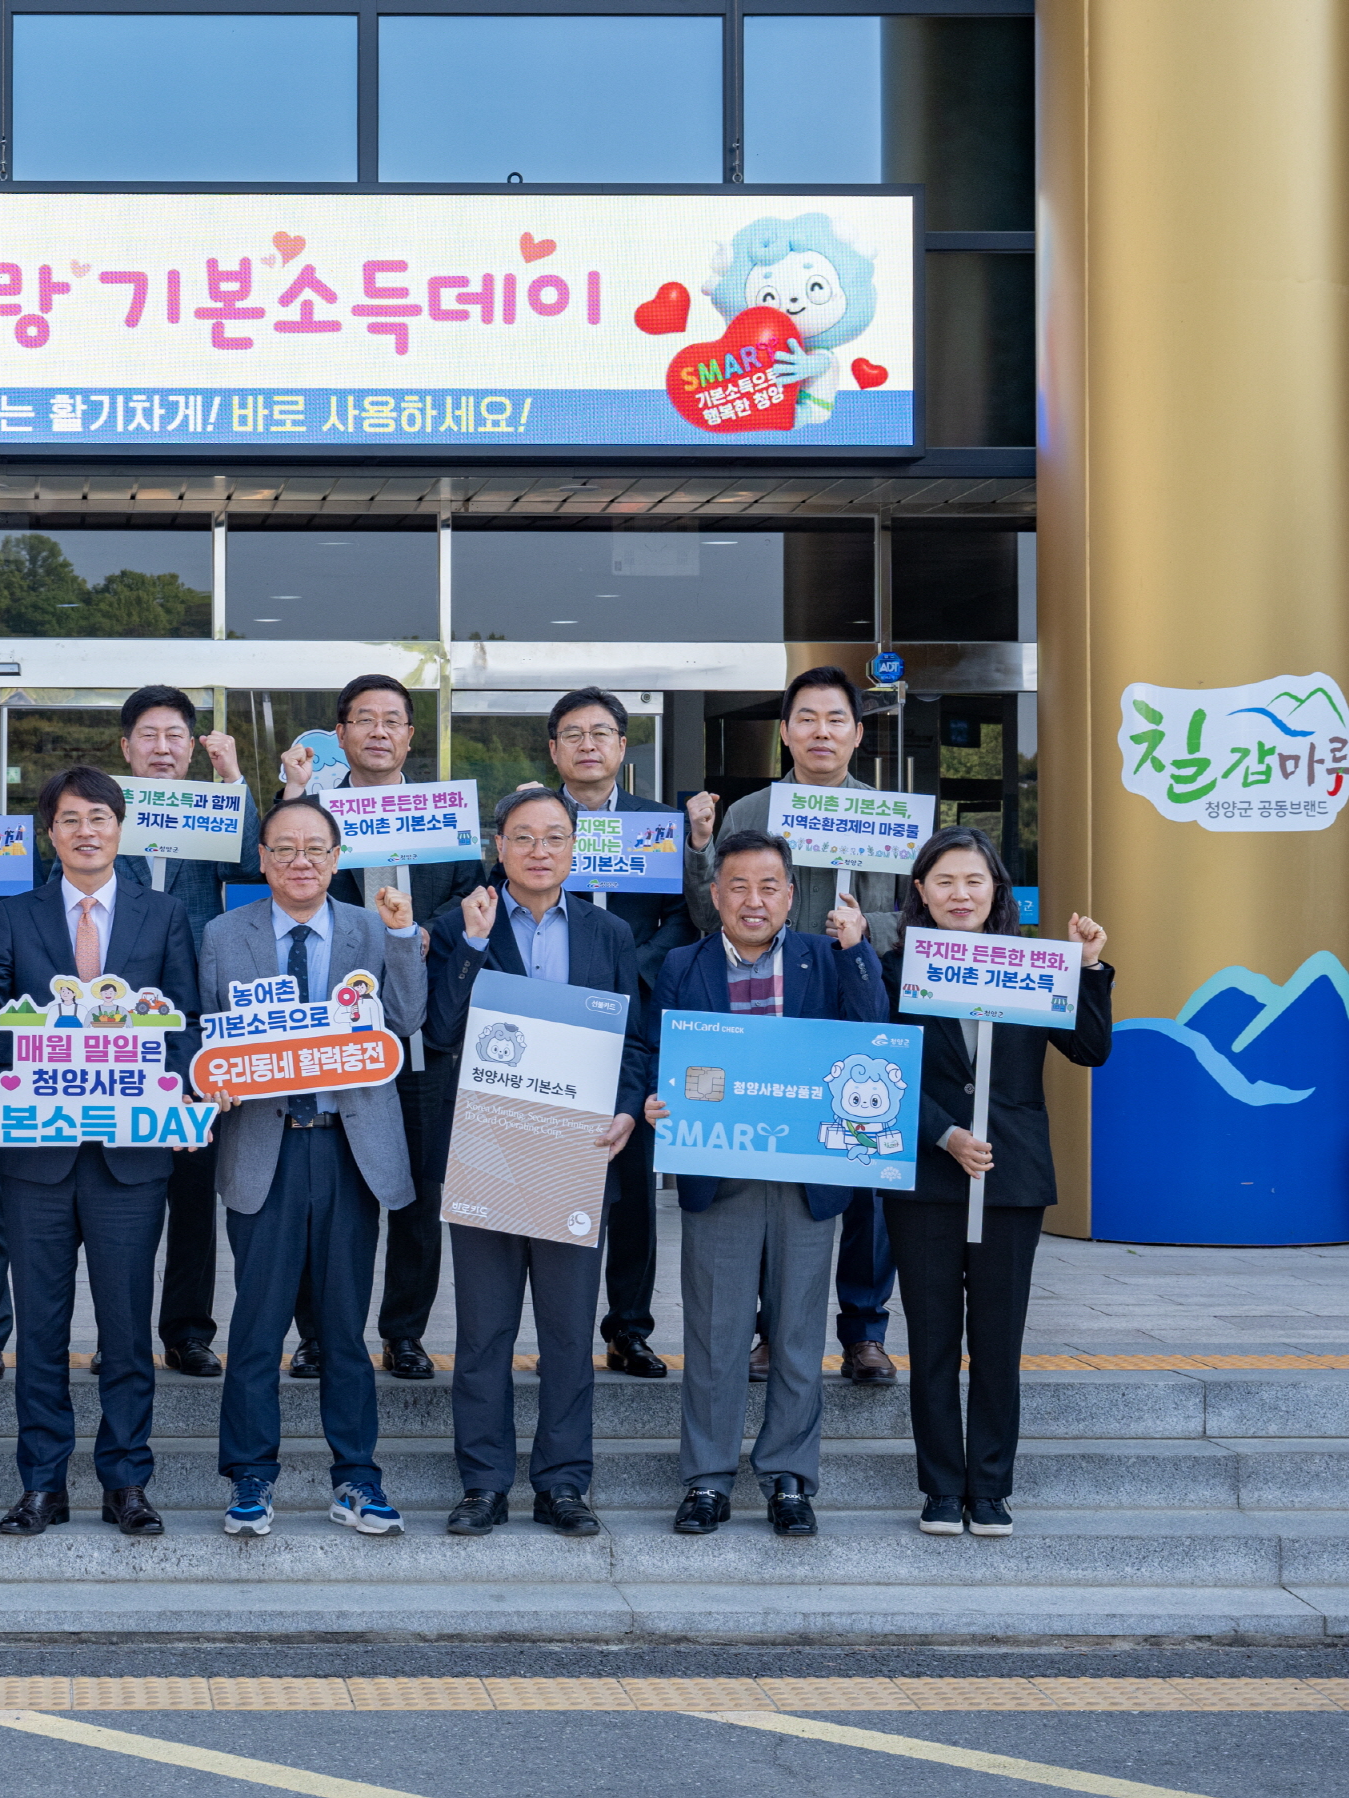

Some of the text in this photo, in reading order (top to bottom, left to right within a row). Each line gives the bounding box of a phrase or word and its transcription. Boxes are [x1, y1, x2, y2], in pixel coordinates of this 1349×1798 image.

[99, 257, 601, 356] 기본소득데이
[49, 393, 218, 433] 활기차게!
[232, 393, 309, 433] 바로
[325, 393, 532, 434] 사용하세요!
[702, 387, 785, 426] 행복한 청양
[879, 661, 900, 672] ADT
[138, 790, 209, 809] 기본소득과
[211, 794, 241, 812] 함께
[329, 791, 469, 816] 작지만 든든한 변화,
[791, 792, 912, 820] 농어촌 기본소득,
[1204, 800, 1329, 819] 청양군 공동브랜드
[136, 812, 239, 834] 커지는 지역상권
[343, 812, 458, 837] 농어촌 기본소득
[577, 818, 621, 835] 지역도
[781, 814, 920, 840] 지역순환경제의 마중물
[572, 838, 622, 854] 아나는
[582, 856, 646, 874] 기본소득
[914, 939, 1069, 972] 작지만 든든한 변화,
[926, 963, 1055, 993] 농어촌 기본소득
[232, 979, 296, 1008] 농어촌
[204, 1005, 331, 1039] 기본소득으로
[721, 1026, 745, 1034] CHECK
[17, 1034, 162, 1063] 매월 말일은
[208, 1041, 386, 1087] 우리동네 활력충전
[32, 1068, 147, 1097] 청양사랑
[471, 1066, 578, 1100] 청양사랑 기본소득
[732, 1080, 824, 1101] 청양사랑상품권
[130, 1106, 216, 1144] DAY
